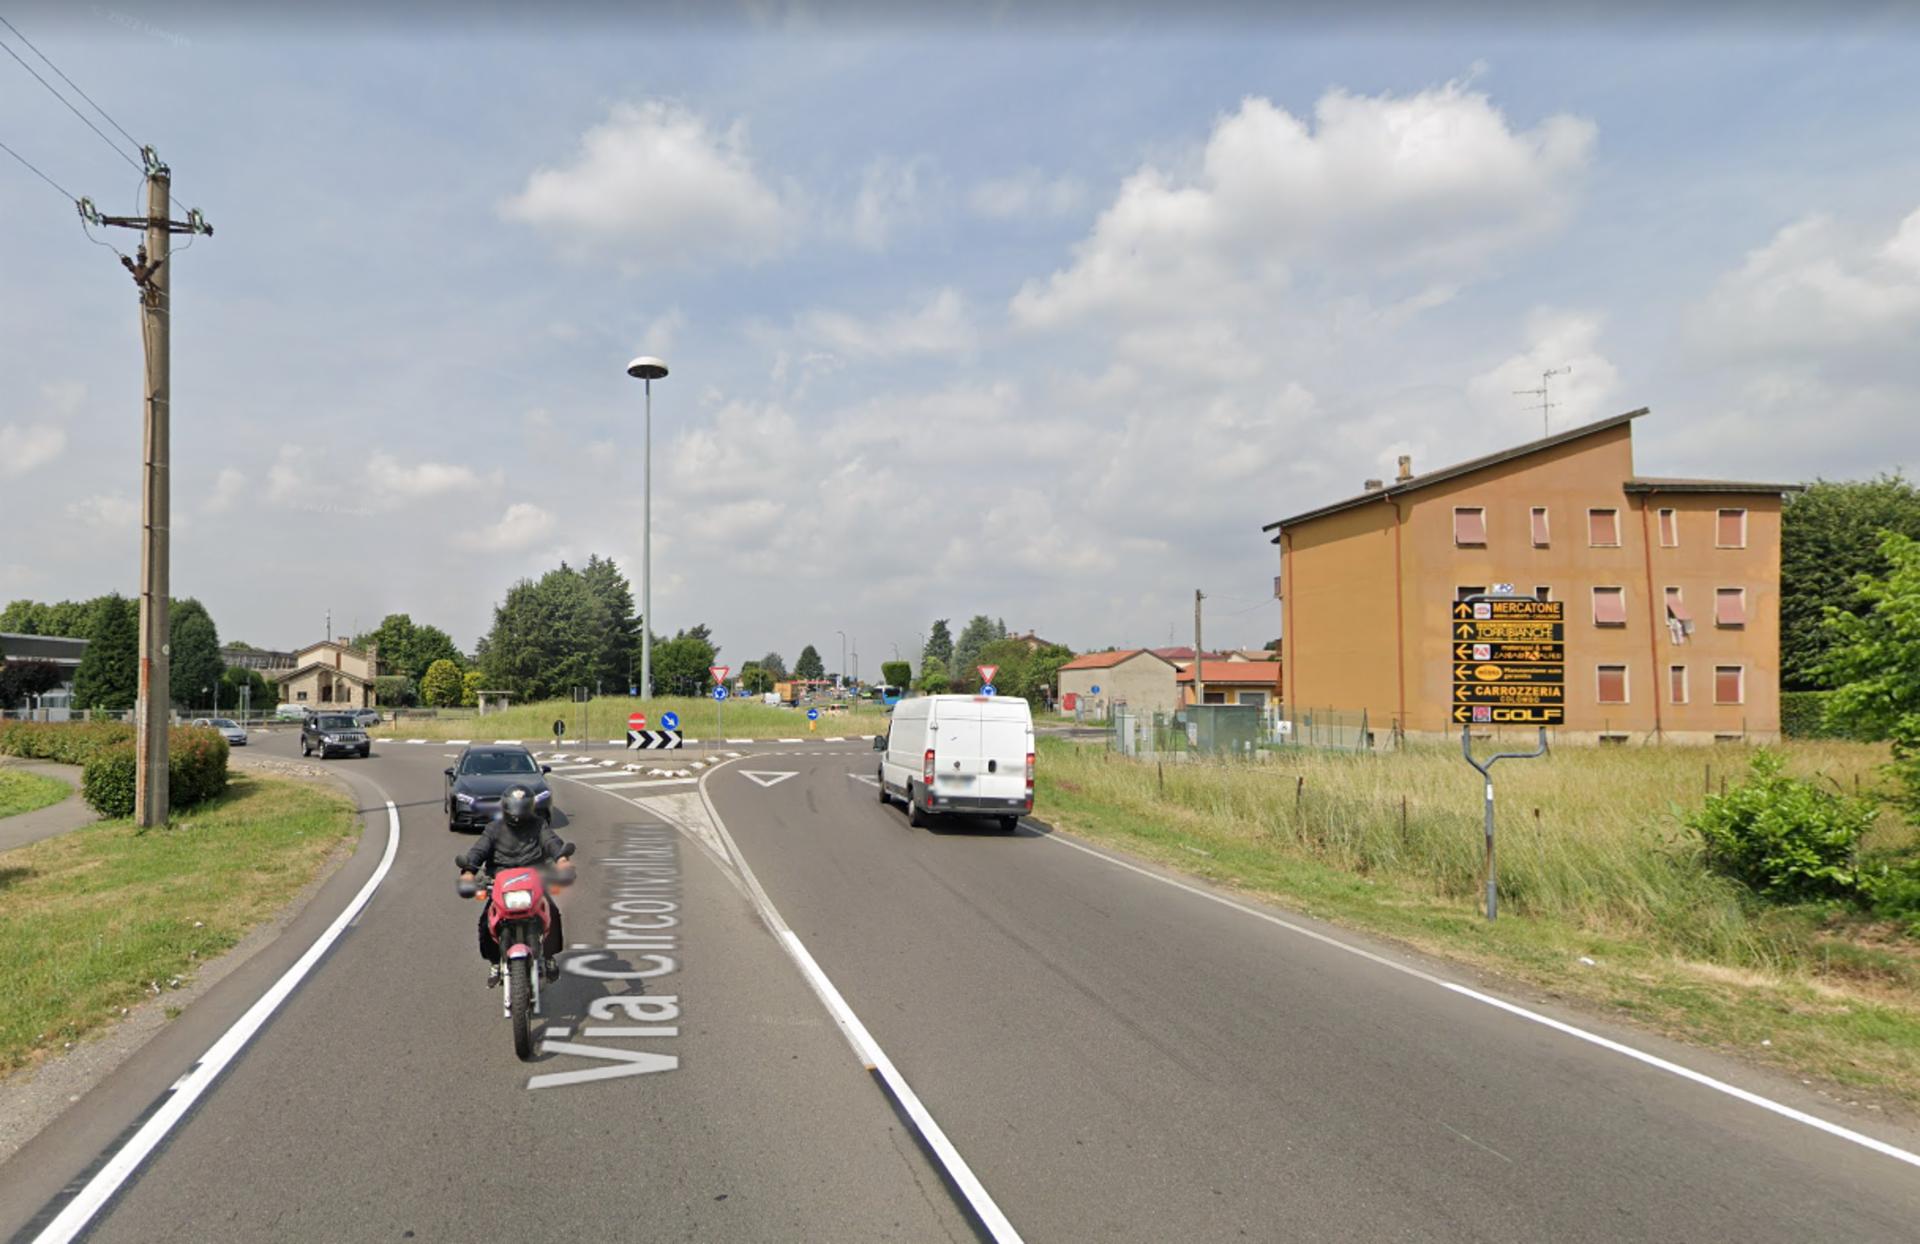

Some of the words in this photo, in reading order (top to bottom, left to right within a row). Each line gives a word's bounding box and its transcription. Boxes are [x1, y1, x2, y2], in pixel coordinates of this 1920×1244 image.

[1493, 602, 1560, 613] MERCATONE
[1475, 686, 1561, 697] CARROZZERIA
[1493, 709, 1562, 721] GOLF
